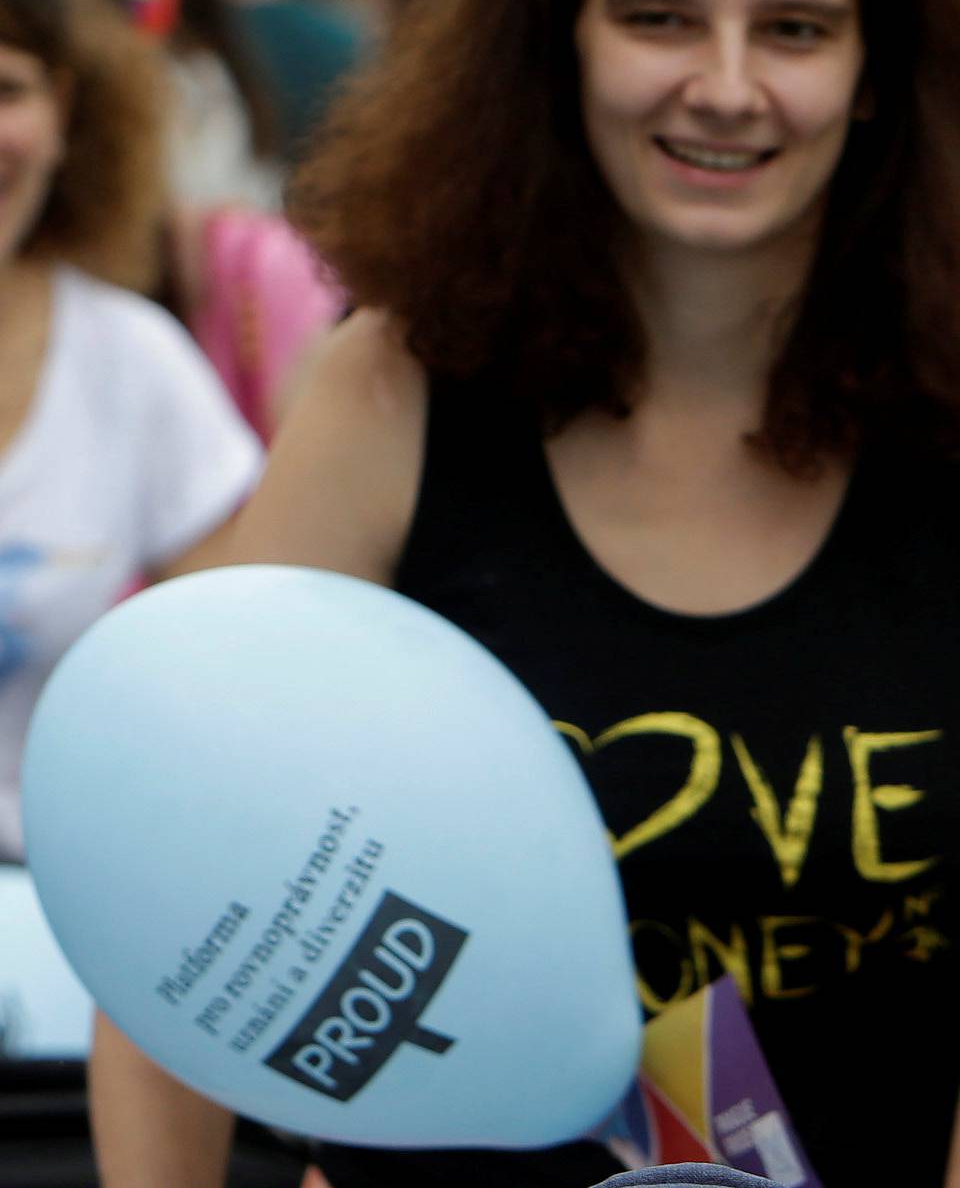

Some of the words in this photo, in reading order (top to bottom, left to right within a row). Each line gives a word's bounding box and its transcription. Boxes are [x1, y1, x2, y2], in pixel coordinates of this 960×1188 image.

[155, 900, 251, 1007] Platforma
[194, 996, 230, 1037] pro
[224, 805, 361, 1000] rovnoprávnost,
[298, 838, 384, 964] diverzitu
[289, 965, 309, 986] a
[292, 917, 436, 1090] PROUD
